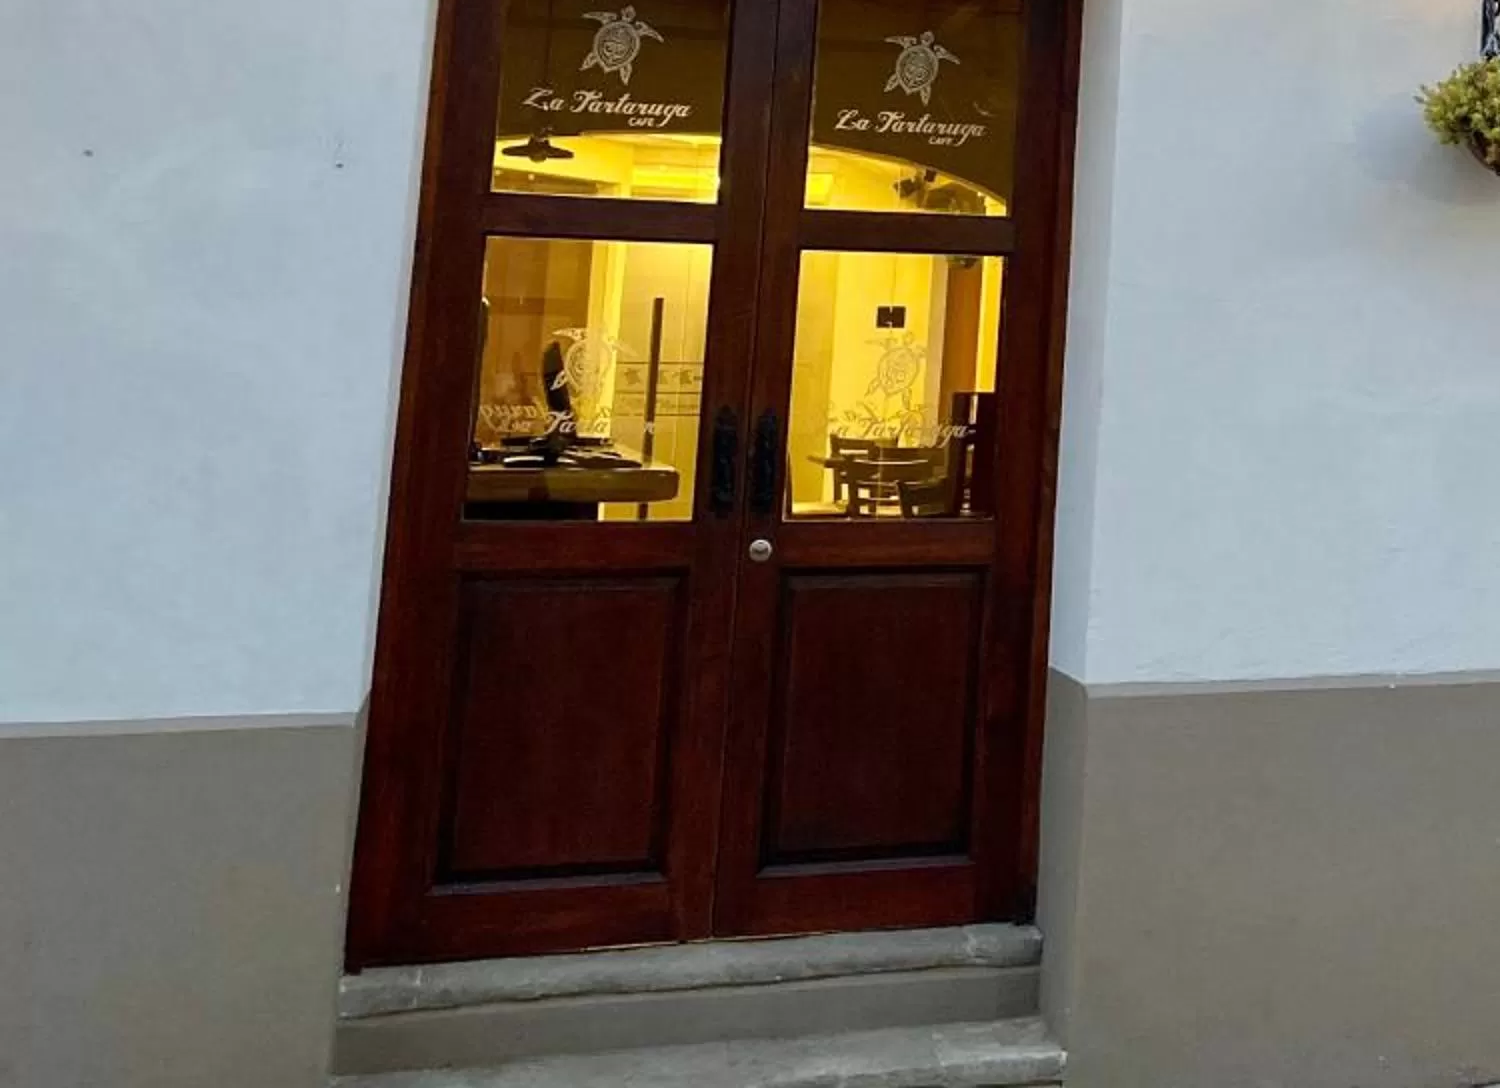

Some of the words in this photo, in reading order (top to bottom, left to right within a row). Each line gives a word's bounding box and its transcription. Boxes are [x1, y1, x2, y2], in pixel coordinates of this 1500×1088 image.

[522, 87, 565, 111] La
[570, 90, 692, 128] Tartaruga
[834, 109, 871, 131] La
[876, 111, 986, 147] Tartaruga
